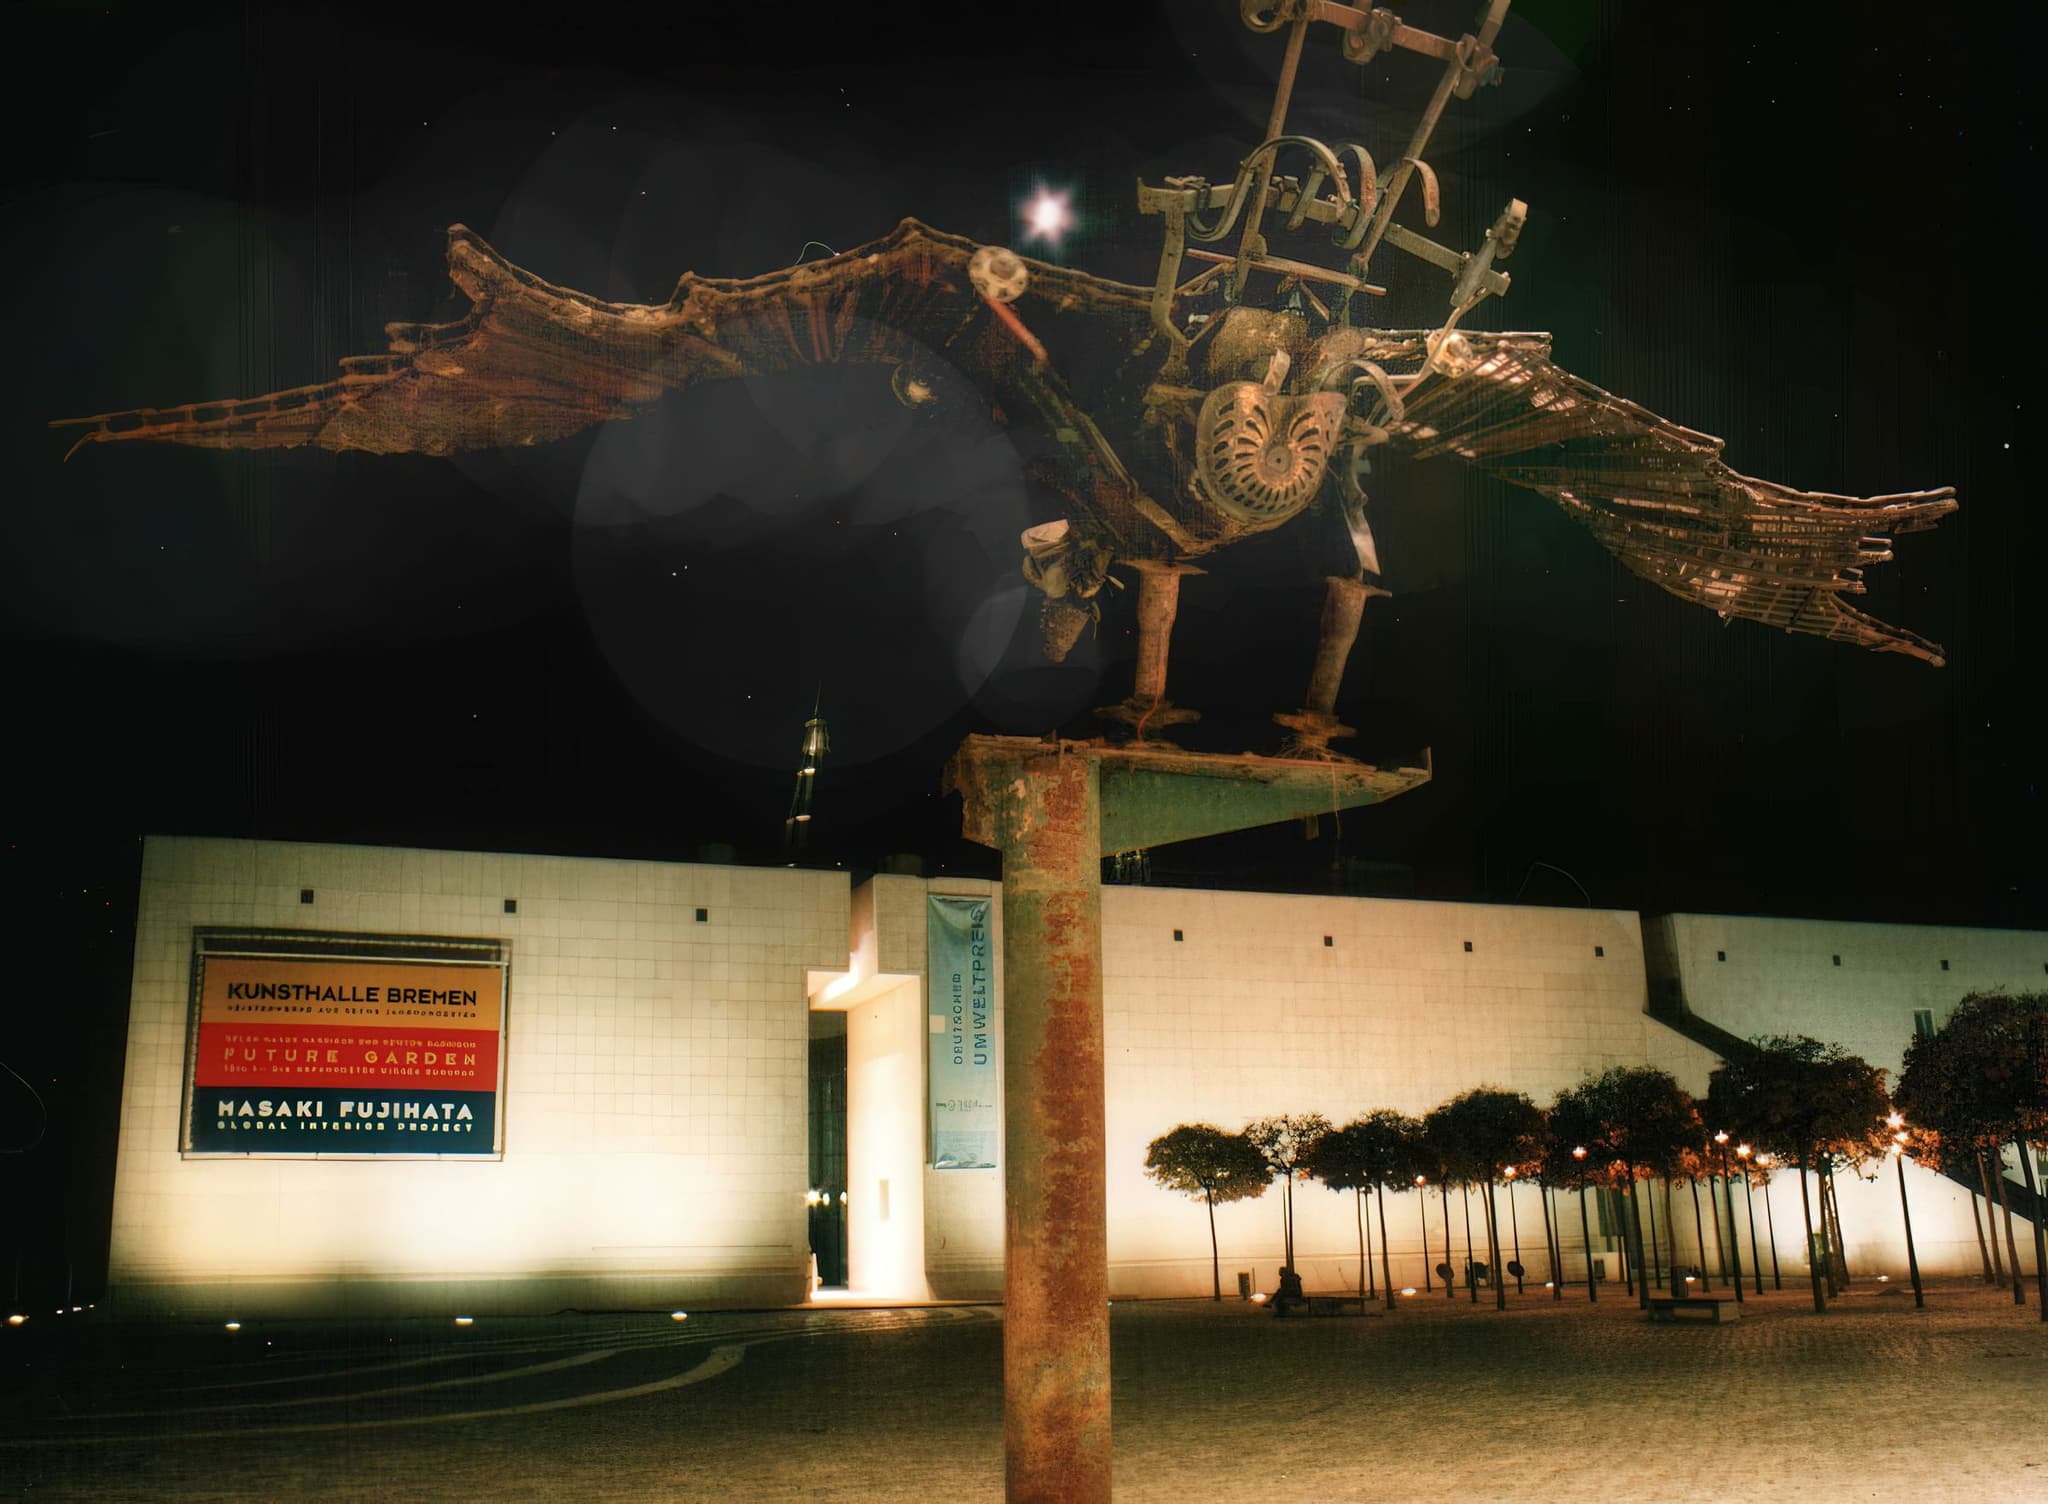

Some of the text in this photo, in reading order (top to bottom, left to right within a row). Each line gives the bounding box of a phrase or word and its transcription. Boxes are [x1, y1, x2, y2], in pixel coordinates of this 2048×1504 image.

[228, 983, 477, 1006] KUNSTHALLE BREMEN
[971, 906, 988, 1065] UMWELTPREIS
[364, 1051, 476, 1066] GARDEN
[218, 1100, 473, 1120] MASAKI FUJIHATA
